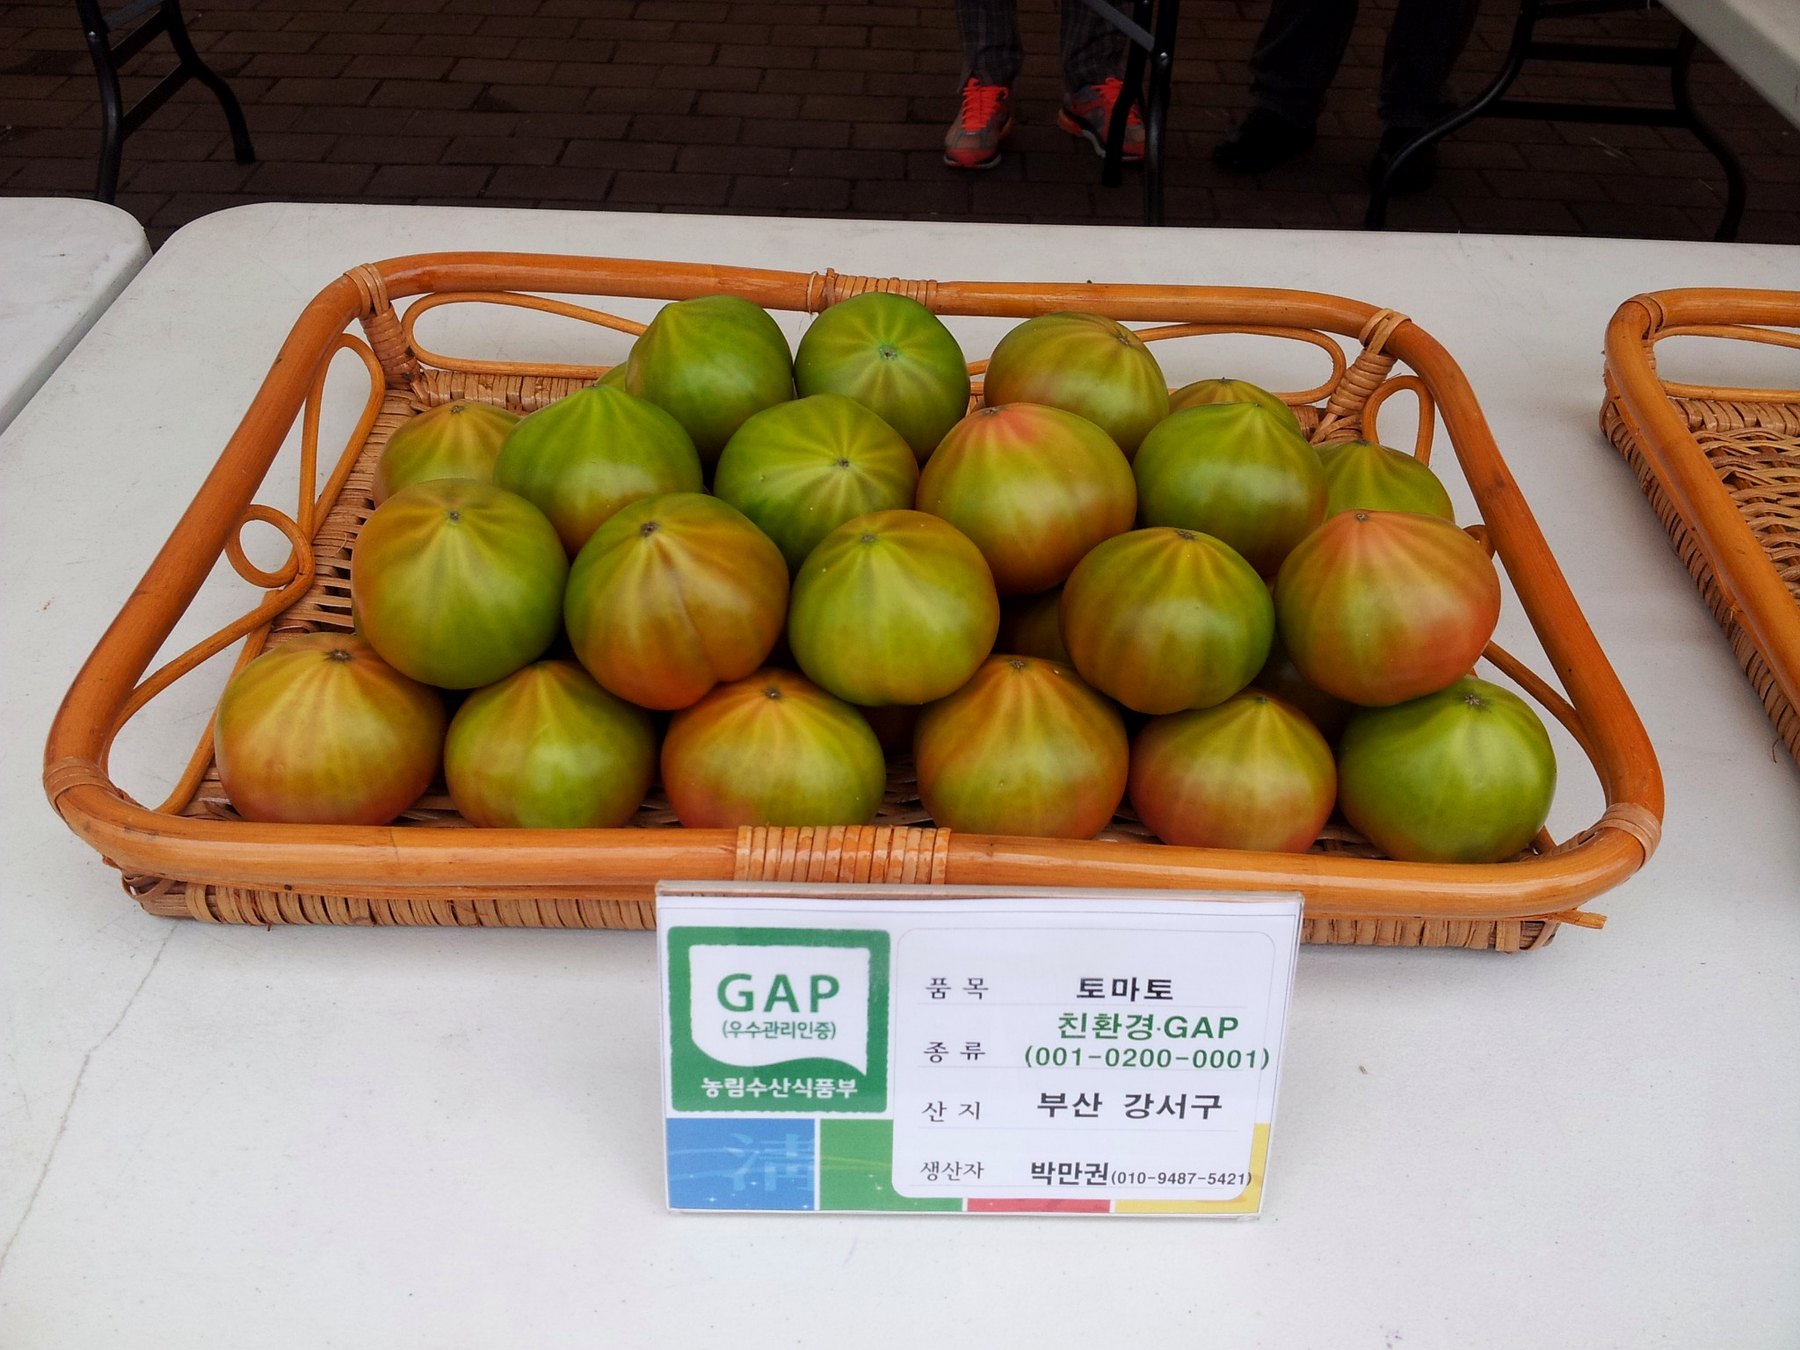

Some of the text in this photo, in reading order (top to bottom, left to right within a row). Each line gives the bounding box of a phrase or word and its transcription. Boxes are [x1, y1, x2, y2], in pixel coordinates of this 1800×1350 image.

[716, 972, 841, 1014] GAP
[1076, 976, 1174, 1002] 토마토
[722, 1020, 837, 1040] (우수관리인증)
[1024, 1045, 1270, 1071] (001-0200-0001)
[701, 1076, 859, 1099] 농림수산식품부
[1036, 1092, 1103, 1118] 부산
[1123, 1092, 1223, 1120] 강서구
[920, 1160, 985, 1182] 생산자
